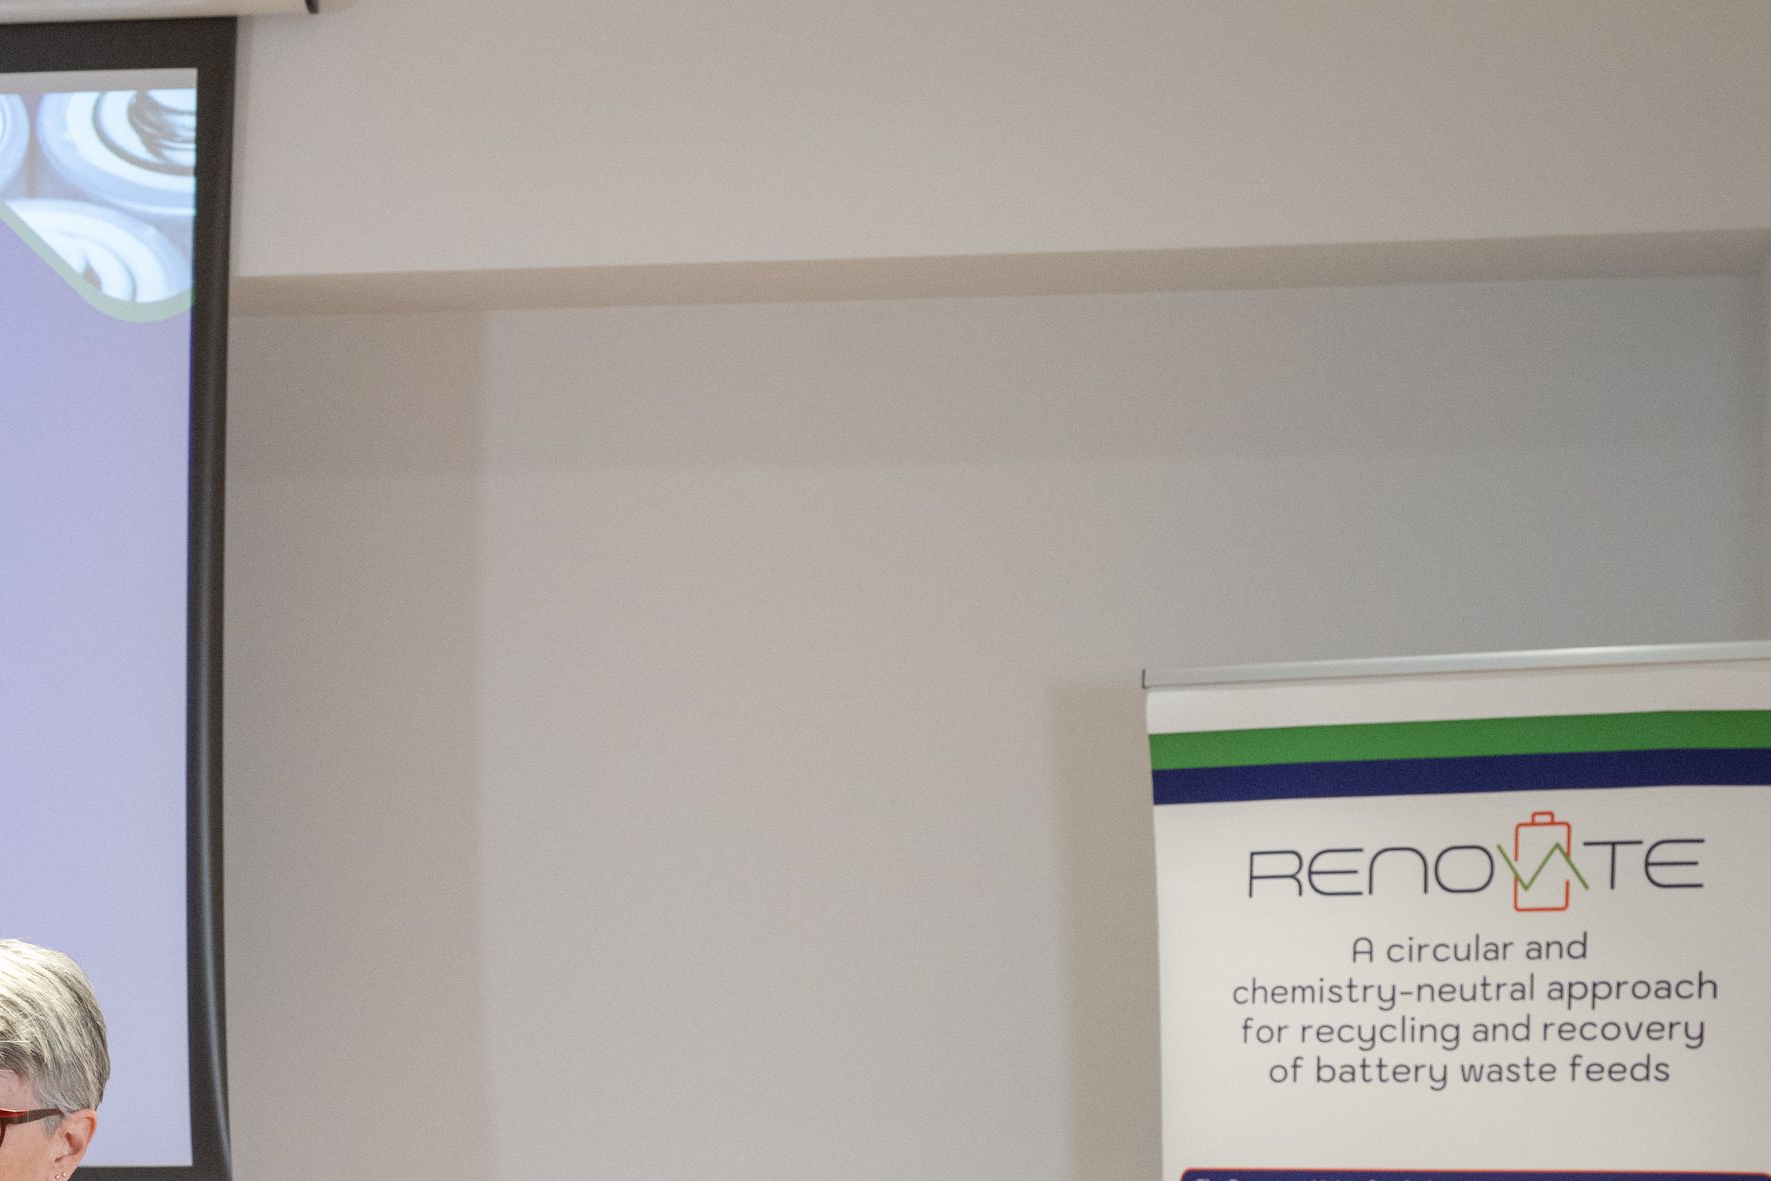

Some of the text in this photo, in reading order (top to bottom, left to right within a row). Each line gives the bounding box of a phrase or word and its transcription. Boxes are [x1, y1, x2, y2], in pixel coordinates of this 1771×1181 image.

[1248, 832, 1705, 901] RENOVATE
[1353, 931, 1588, 963] A circular and
[1234, 970, 1718, 1011] chemistry-neutral approach
[1243, 1014, 1705, 1052] for recycling and recovery
[1270, 1053, 1670, 1091] of battery waste feeds
